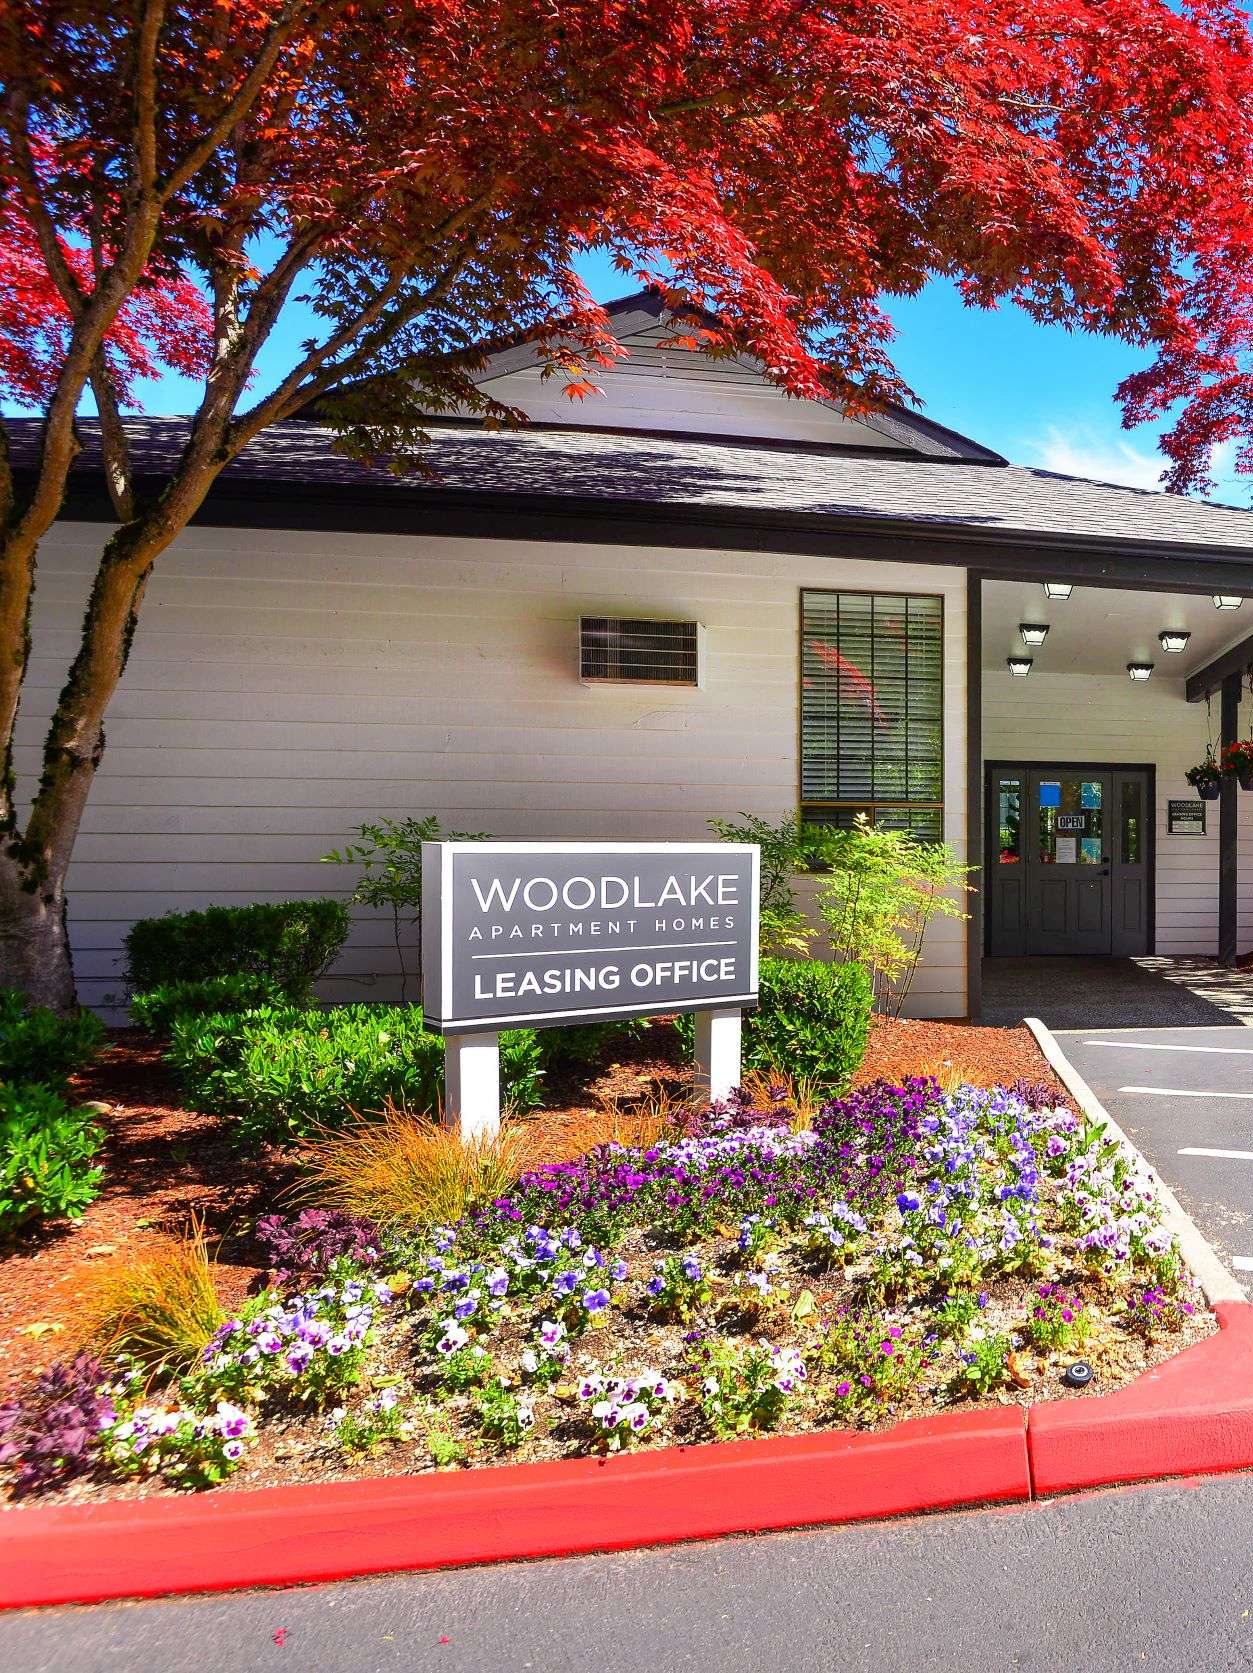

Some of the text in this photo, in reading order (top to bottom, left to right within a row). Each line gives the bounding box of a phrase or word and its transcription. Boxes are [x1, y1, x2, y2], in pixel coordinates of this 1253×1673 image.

[1060, 815, 1083, 828] OPEN
[470, 873, 739, 913] WOODLAKE
[468, 916, 736, 941] APARTMENT HOMES
[473, 957, 736, 1000] LEASING OFFICE
